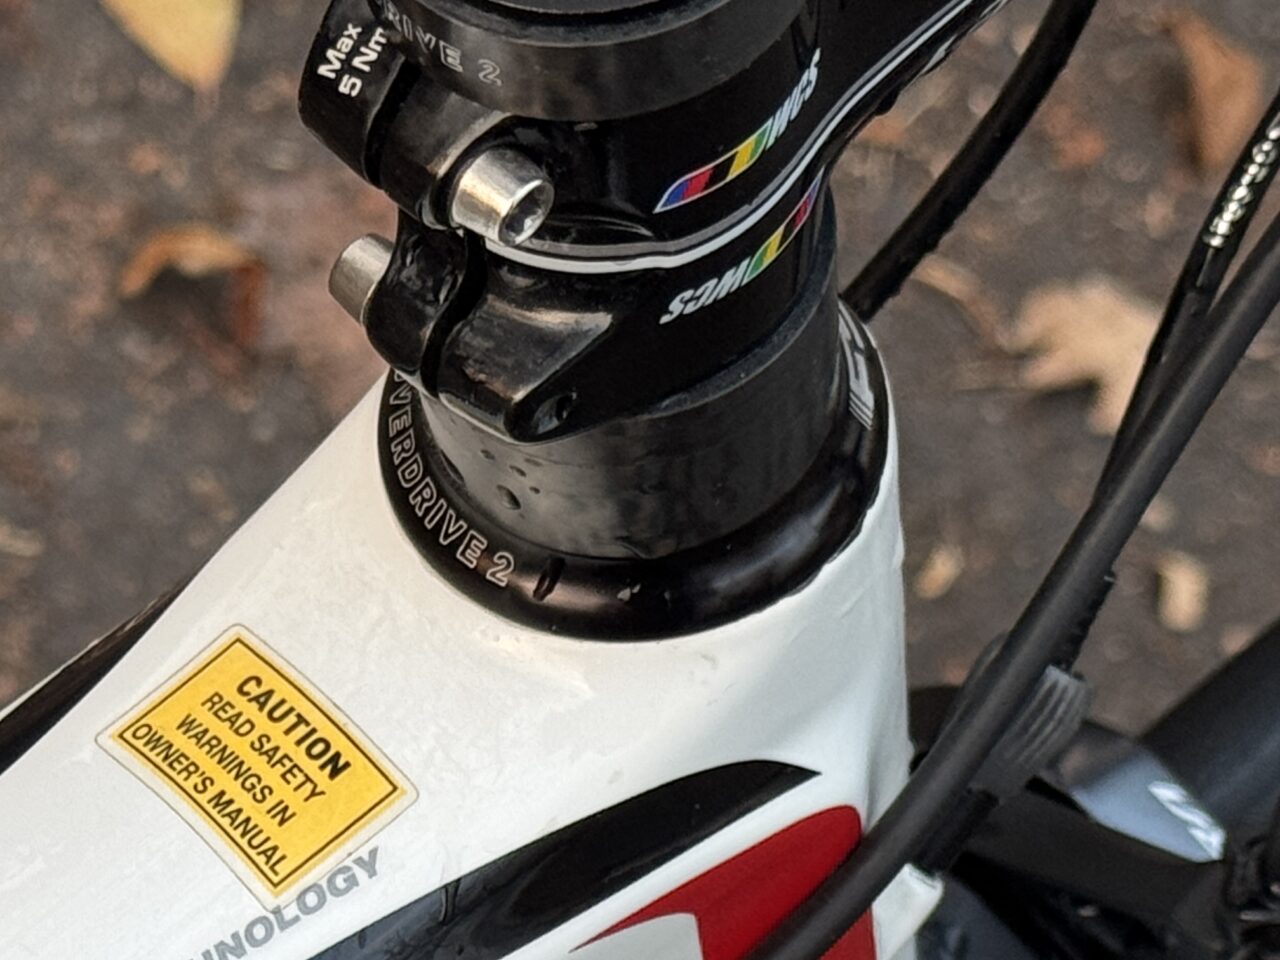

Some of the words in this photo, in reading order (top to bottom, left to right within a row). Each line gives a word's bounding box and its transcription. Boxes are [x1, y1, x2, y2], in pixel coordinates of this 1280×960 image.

[317, 23, 363, 80] Max
[338, 74, 363, 98] 5
[352, 27, 388, 73] Nm
[477, 58, 503, 87] 2
[659, 253, 752, 324] WCS
[485, 551, 515, 588] 2
[200, 691, 256, 738] READ
[249, 733, 327, 803] SAFETY
[236, 675, 352, 781] CAUTION
[131, 722, 215, 795] OWNER'S
[207, 789, 289, 876] MANUAL
[175, 713, 274, 805] WARNINGS
[266, 799, 298, 828] IN
